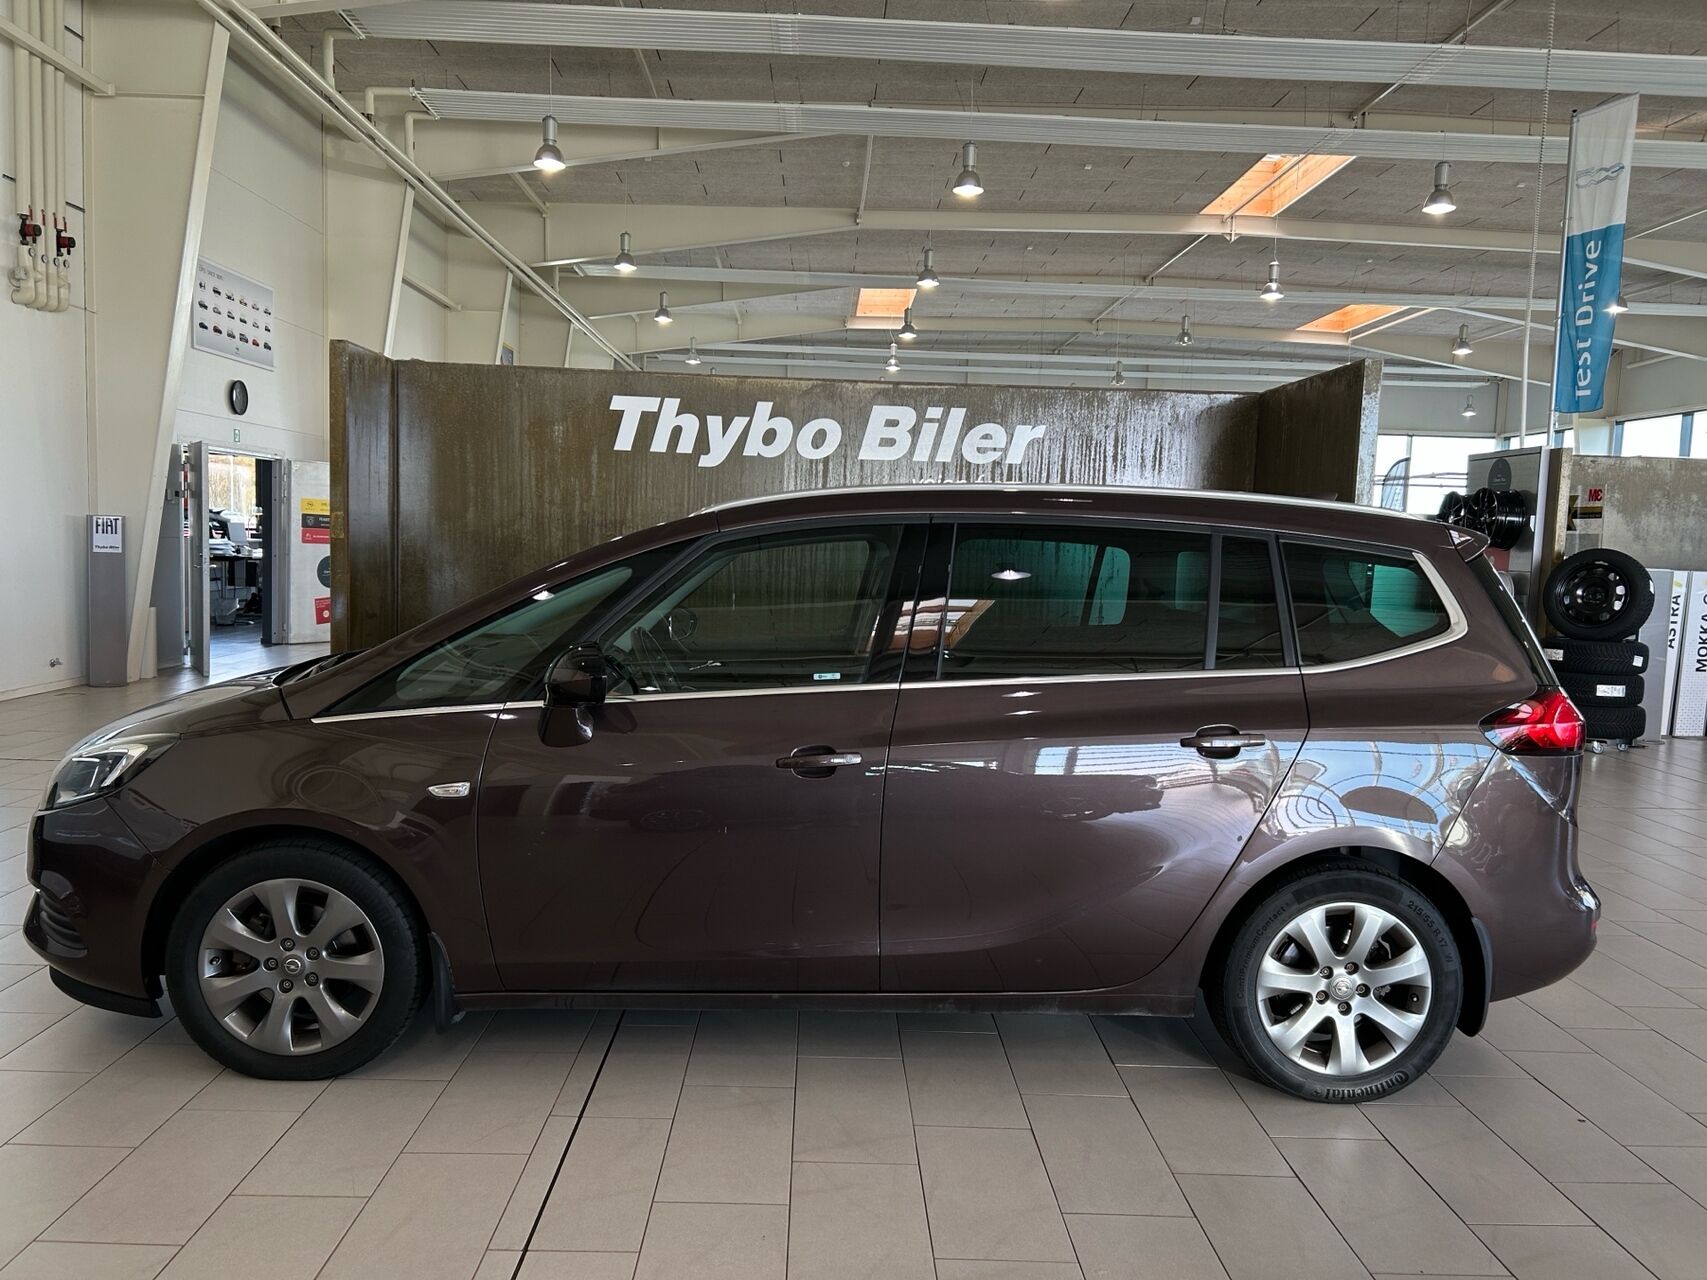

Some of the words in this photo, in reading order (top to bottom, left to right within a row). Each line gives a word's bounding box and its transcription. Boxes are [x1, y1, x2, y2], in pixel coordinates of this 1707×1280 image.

[1575, 239, 1602, 327] Drive
[1575, 337, 1592, 400] Test
[609, 395, 842, 468] Thybo
[858, 405, 1046, 465] Biler
[95, 517, 120, 535] FIAT
[1407, 900, 1436, 928] 215/55
[1325, 1069, 1410, 1100] Continental
